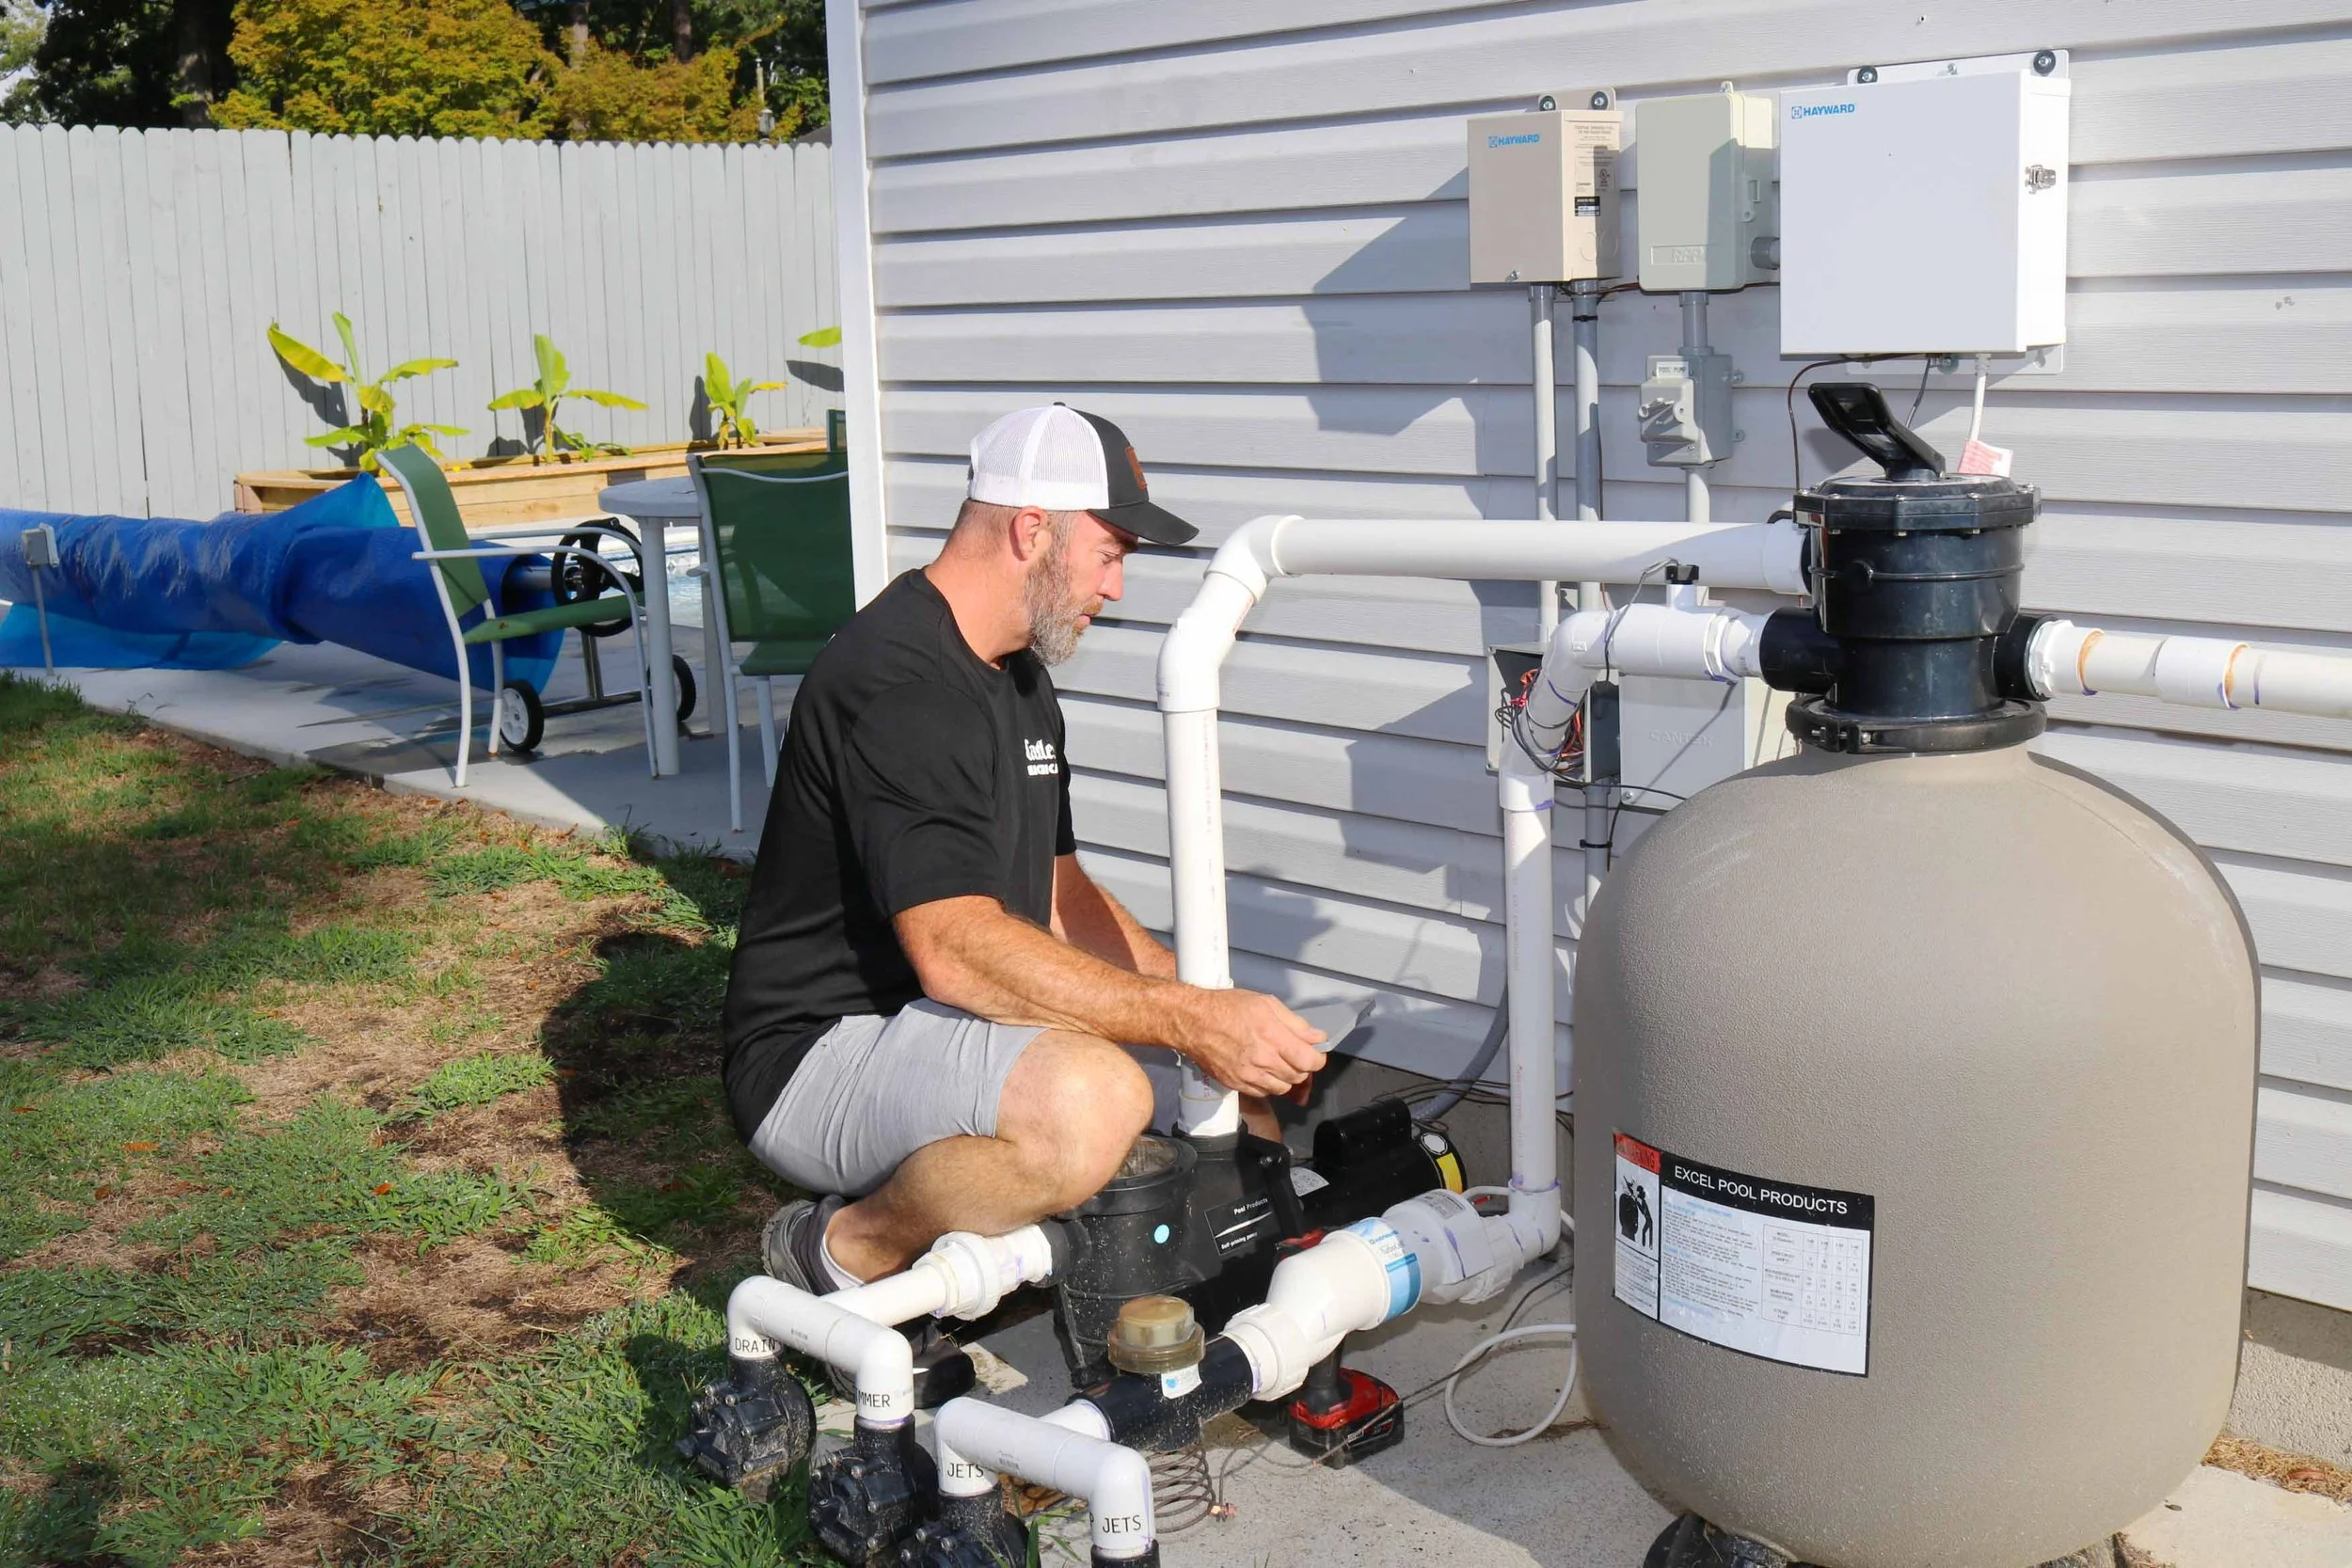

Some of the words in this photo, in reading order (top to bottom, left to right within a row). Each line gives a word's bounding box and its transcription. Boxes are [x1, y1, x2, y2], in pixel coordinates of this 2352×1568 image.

[1804, 103, 1856, 117] HAYWARD
[1498, 134, 1540, 146] HAYWARD
[1675, 1164, 1715, 1190] EXCEL
[1718, 1179, 1757, 1200] POOL
[1760, 1189, 1848, 1215] PRODUCTS
[1233, 1205, 1247, 1215] Pool
[735, 1337, 776, 1353] DRAIN
[946, 1462, 985, 1479] JETS
[1102, 1513, 1142, 1534] JETS
